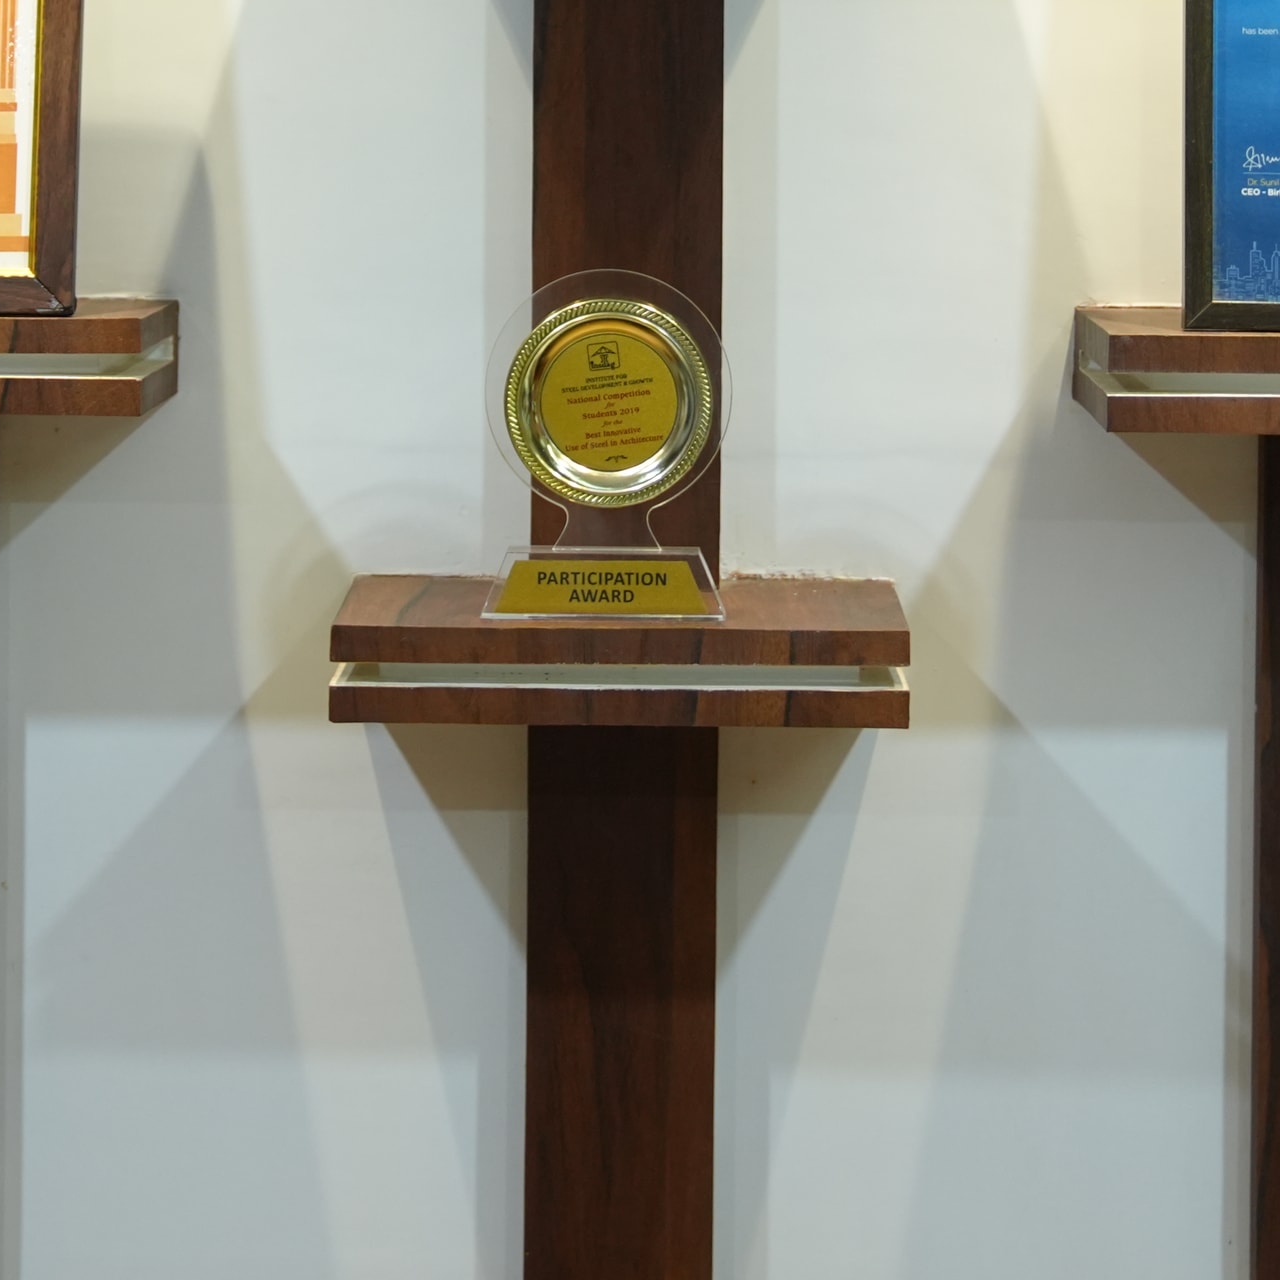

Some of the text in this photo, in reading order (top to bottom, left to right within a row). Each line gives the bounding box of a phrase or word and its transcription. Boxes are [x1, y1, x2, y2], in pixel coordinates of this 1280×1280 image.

[1242, 27, 1256, 35] has
[1258, 27, 1278, 35] been
[1260, 178, 1279, 186] Sunil
[1241, 188, 1260, 196] CEO
[585, 375, 614, 383] INSTITUTE
[581, 382, 622, 391] DEVELOPMENT
[567, 389, 650, 405] National Competition
[582, 407, 640, 420] Students 2019
[585, 427, 641, 439] Best Innovative
[581, 442, 588, 450] of
[590, 440, 608, 449] Steel
[620, 435, 663, 445] Architecture
[537, 571, 667, 587] PARTICIPATION
[569, 589, 635, 604] AWARD
